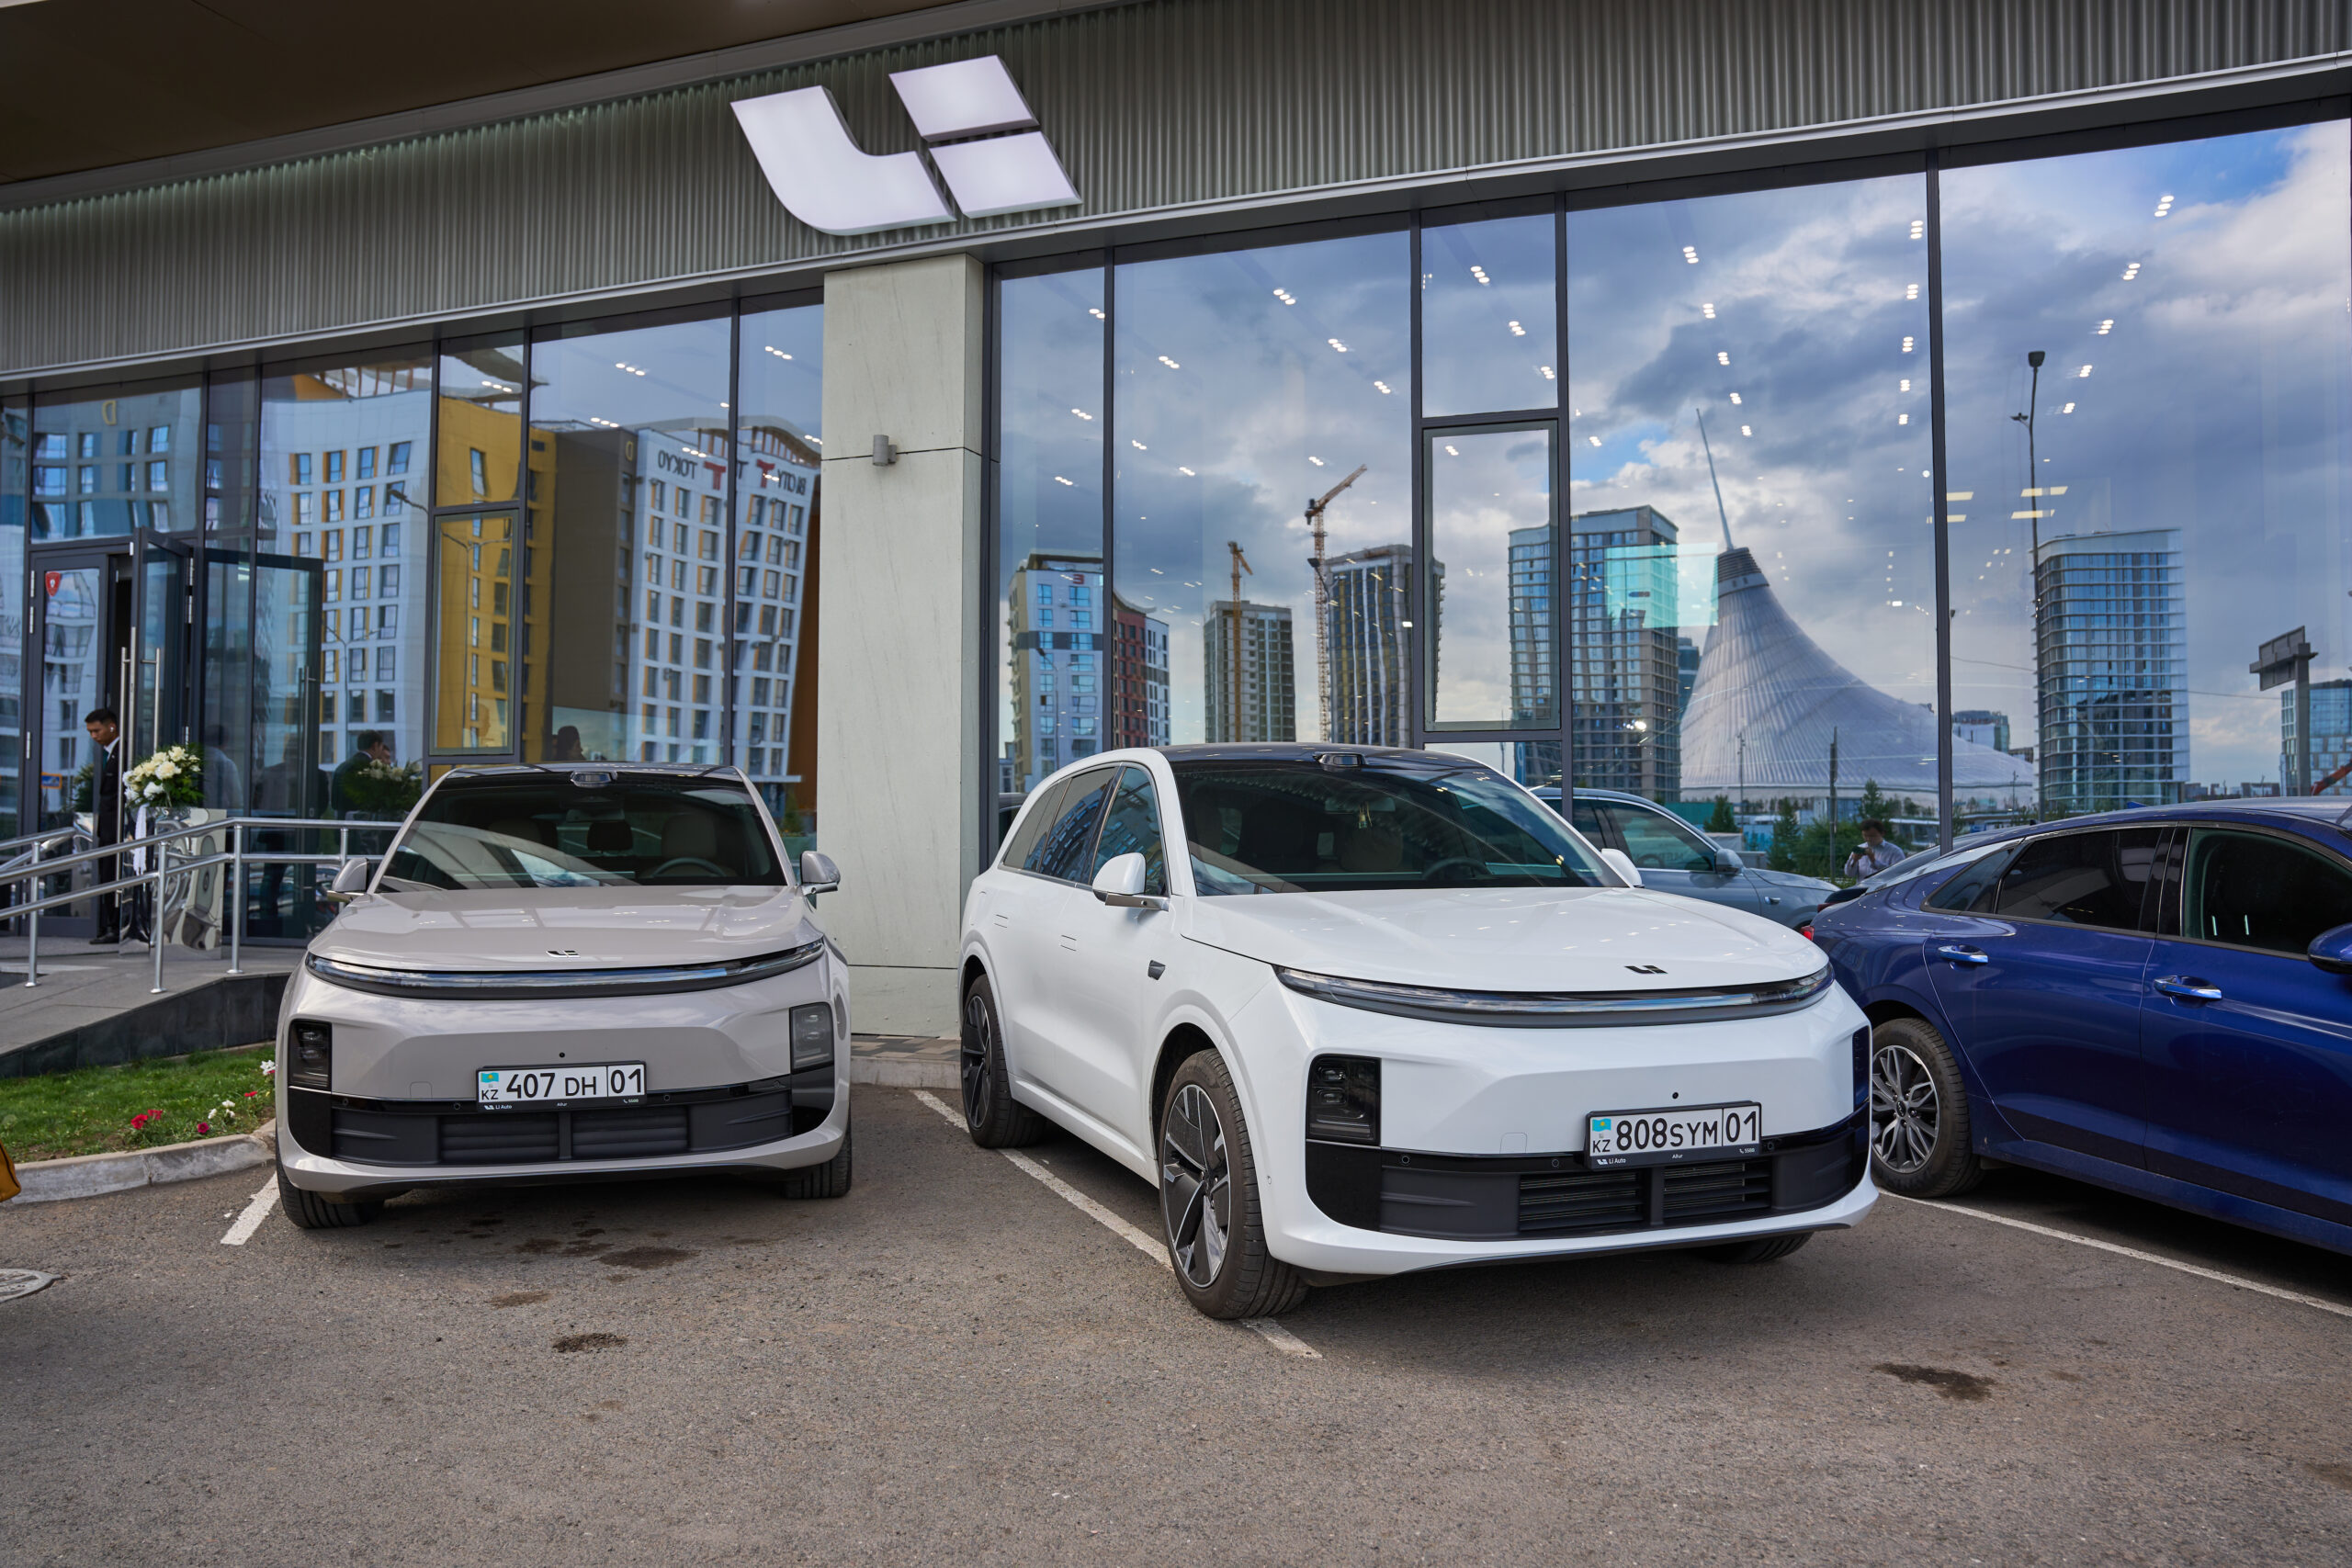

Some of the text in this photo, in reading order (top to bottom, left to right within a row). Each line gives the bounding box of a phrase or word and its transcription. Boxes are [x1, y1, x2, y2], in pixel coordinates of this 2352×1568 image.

[481, 1089, 499, 1100] KZ
[506, 1068, 641, 1099] 407 DH 01
[1725, 1111, 1757, 1142] 01
[1592, 1139, 1611, 1153] KZ
